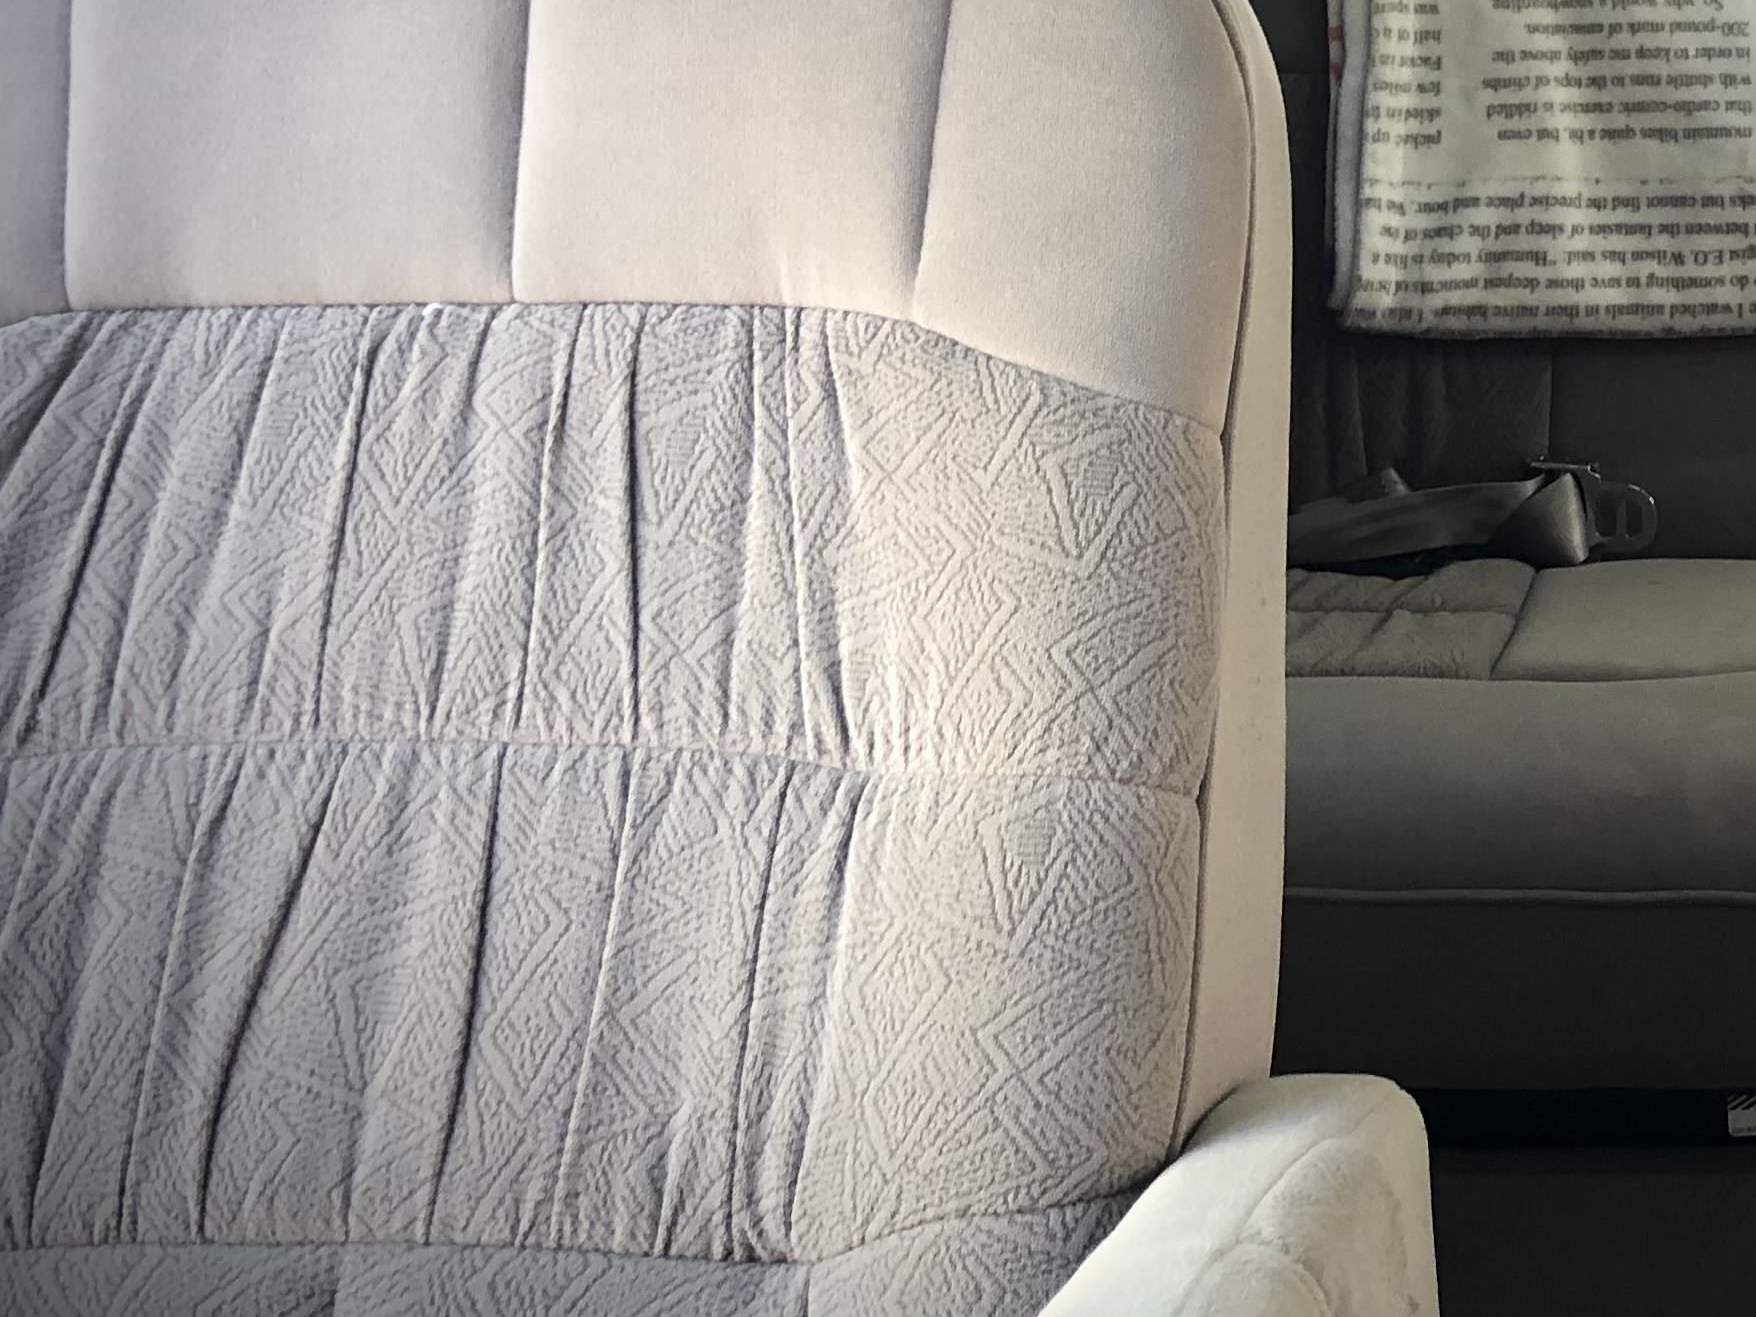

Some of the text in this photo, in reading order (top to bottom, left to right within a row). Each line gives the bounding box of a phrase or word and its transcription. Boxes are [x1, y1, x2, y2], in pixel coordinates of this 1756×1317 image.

[1413, 2, 1440, 16] was
[1383, 27, 1442, 45] half of a
[1523, 18, 1751, 39] 200-pound mark of emaciation.
[1397, 54, 1443, 72] Factor
[1490, 45, 1752, 66] in order to keep me safely above the
[1414, 81, 1442, 98] few
[1481, 72, 1753, 94] with shuttle runs to the tops of climbs
[1386, 108, 1403, 123] in
[1485, 100, 1753, 121] that cardio-centric exercise is riddled
[1371, 127, 1391, 146] up
[1496, 128, 1533, 142] even
[1535, 128, 1560, 145] but
[1587, 128, 1597, 142] a
[1599, 124, 1637, 144] quite
[1639, 126, 1679, 145] bikes
[1682, 126, 1753, 144] mountain
[1452, 196, 1481, 213] and
[1485, 192, 1526, 213] place
[1529, 192, 1582, 212] precise
[1585, 195, 1608, 212] the
[1611, 196, 1641, 213] find
[1646, 195, 1696, 211] cannot
[1700, 195, 1725, 212] but
[1403, 228, 1418, 244] of
[1422, 224, 1464, 242] chaos
[1467, 224, 1491, 241] the
[1494, 223, 1521, 241] and
[1525, 219, 1565, 240] sleep
[1569, 224, 1585, 241] of
[1588, 222, 1653, 240] fantasies
[1658, 223, 1681, 239] the
[1685, 222, 1749, 239] between
[1372, 253, 1380, 266] a
[1384, 254, 1408, 270] like
[1411, 254, 1424, 267] is
[1430, 249, 1472, 270] today
[1601, 251, 1626, 267] has
[1630, 250, 1685, 267] Wilson
[1689, 250, 1723, 267] E.O.
[1394, 281, 1409, 296] of
[1414, 277, 1479, 296] moments
[1483, 273, 1540, 294] deepest
[1545, 277, 1585, 293] those
[1591, 276, 1622, 290] save
[1626, 277, 1641, 291] to
[1646, 273, 1725, 293] something
[1730, 275, 1749, 291] do
[1493, 305, 1539, 321] native
[1544, 305, 1580, 321] their
[1584, 304, 1599, 320] in
[1605, 304, 1666, 321] animals
[1669, 303, 1733, 320] watched
[1737, 303, 1744, 319] I
